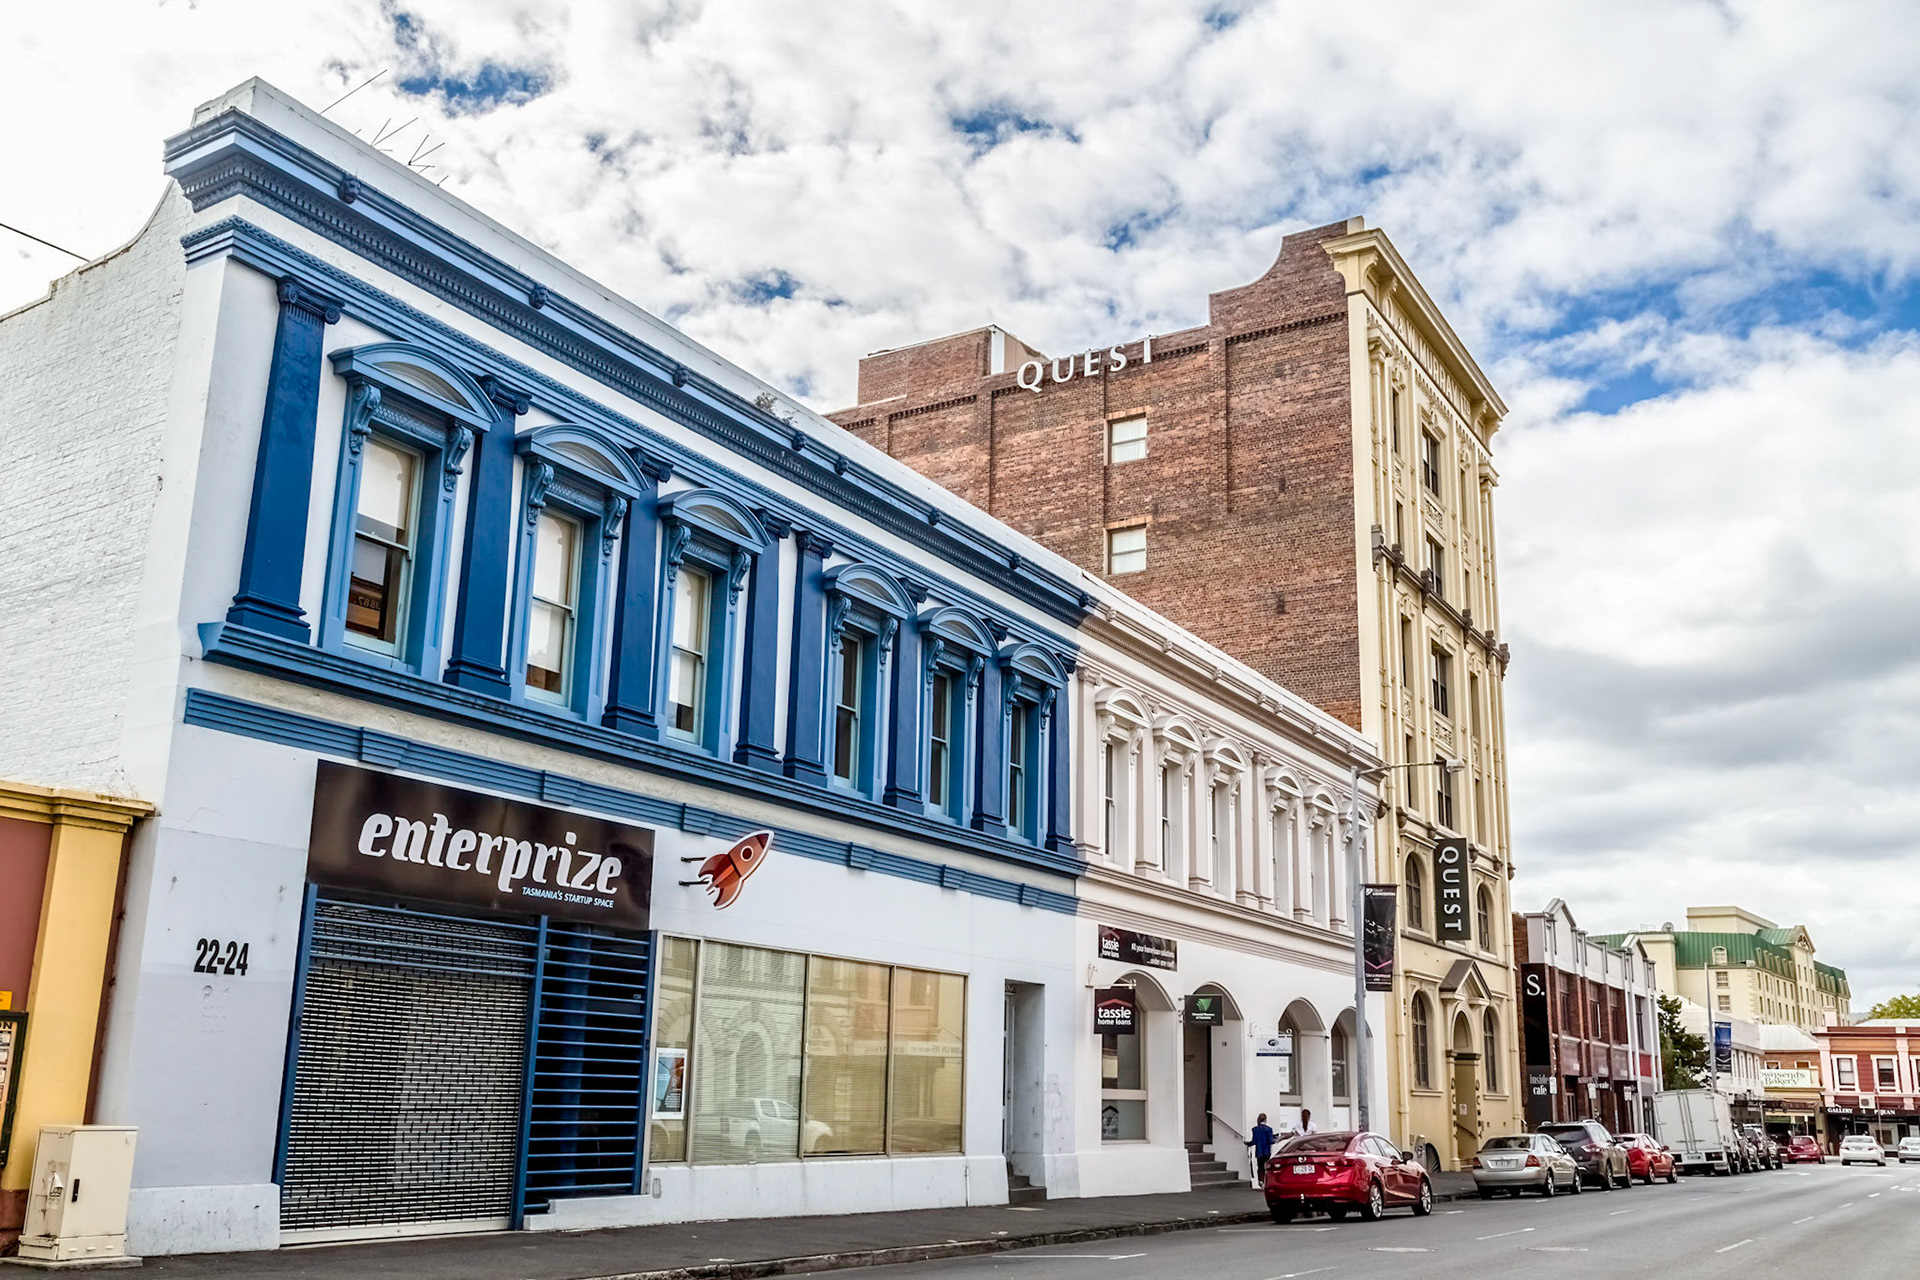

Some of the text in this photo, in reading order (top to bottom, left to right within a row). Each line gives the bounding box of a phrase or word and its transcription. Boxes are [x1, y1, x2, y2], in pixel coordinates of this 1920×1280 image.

[1017, 335, 1156, 394] QUEST
[357, 812, 624, 894] enterprize
[1438, 846, 1462, 932] QUEST
[522, 886, 615, 908] TASMANIA'S STARTUP SPACE
[1102, 937, 1120, 951] tassie
[193, 938, 249, 976] 22-24
[1102, 948, 1120, 958] home loans
[1136, 945, 1144, 953] your
[1161, 948, 1175, 958] solutions
[1526, 973, 1546, 996] S.
[1098, 1006, 1132, 1018] tassie
[1529, 1074, 1549, 1084] inside
[1765, 1078, 1797, 1086] Bakery
[1533, 1085, 1547, 1095] cafe
